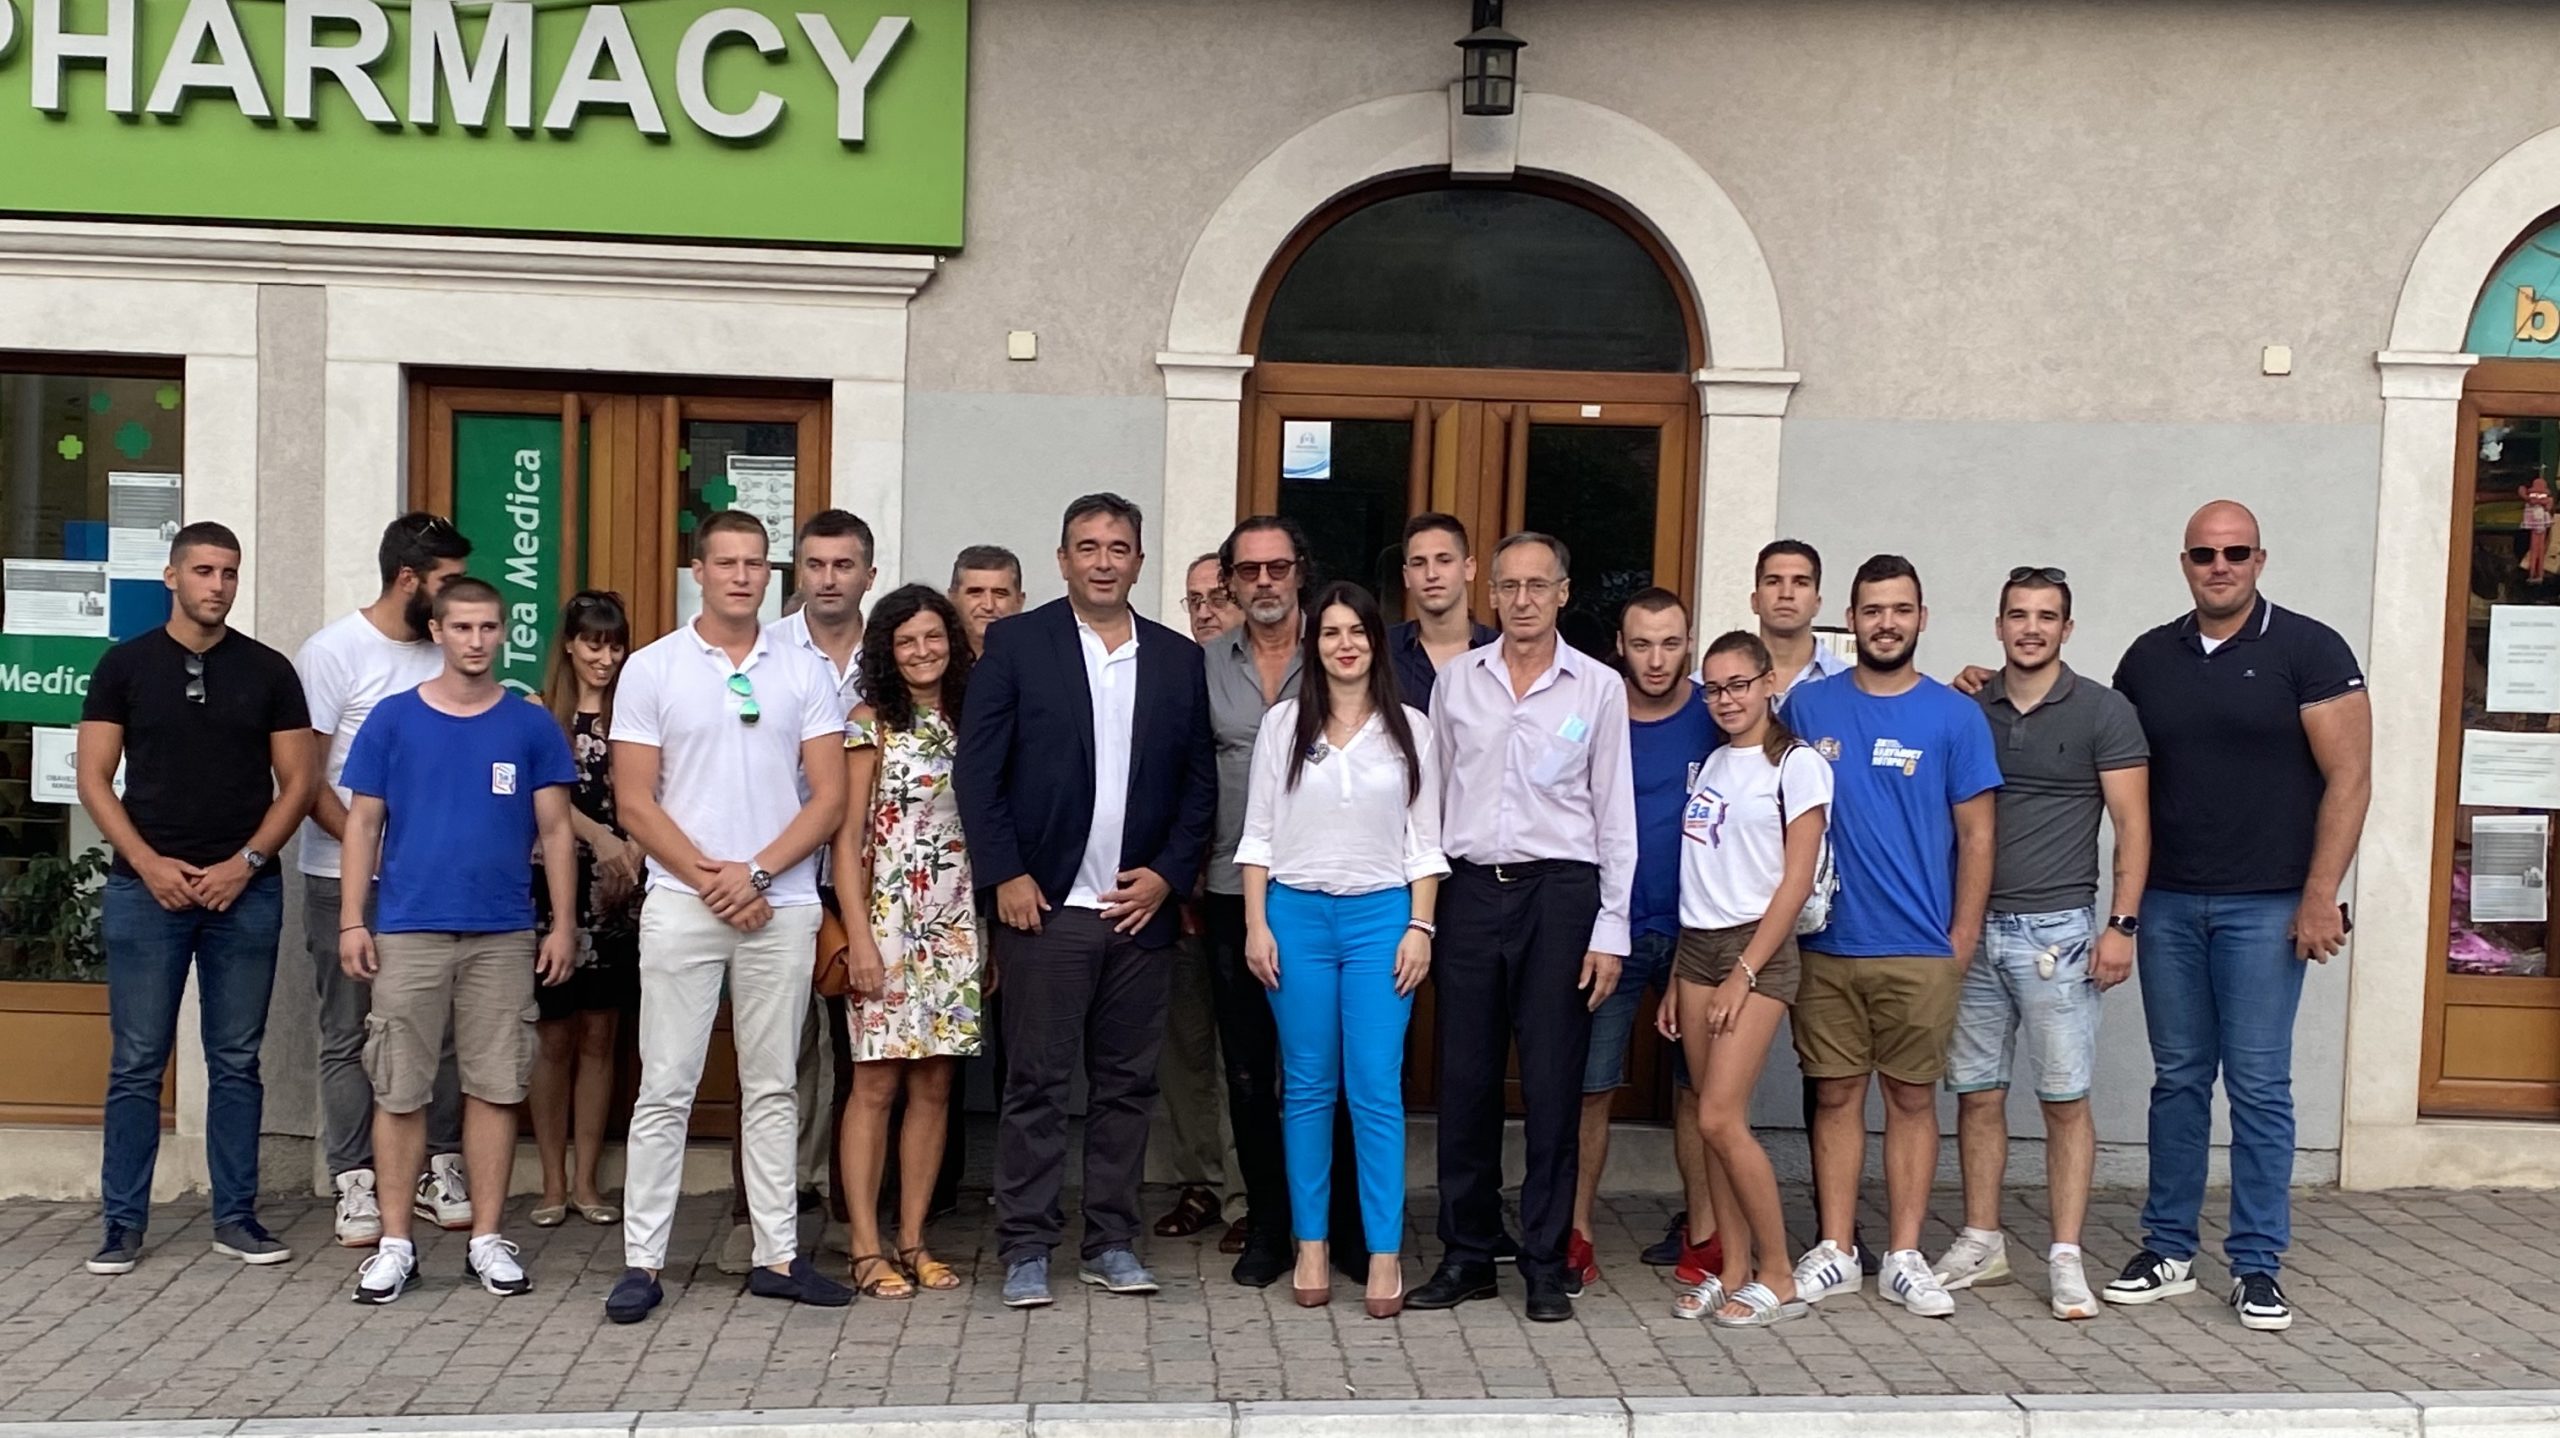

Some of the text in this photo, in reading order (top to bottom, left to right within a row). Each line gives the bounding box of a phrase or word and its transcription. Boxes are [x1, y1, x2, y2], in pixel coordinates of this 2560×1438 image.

[0, 0, 914, 143] HARMACY
[504, 449, 541, 668] Tea Medica
[0, 663, 91, 696] Medic
